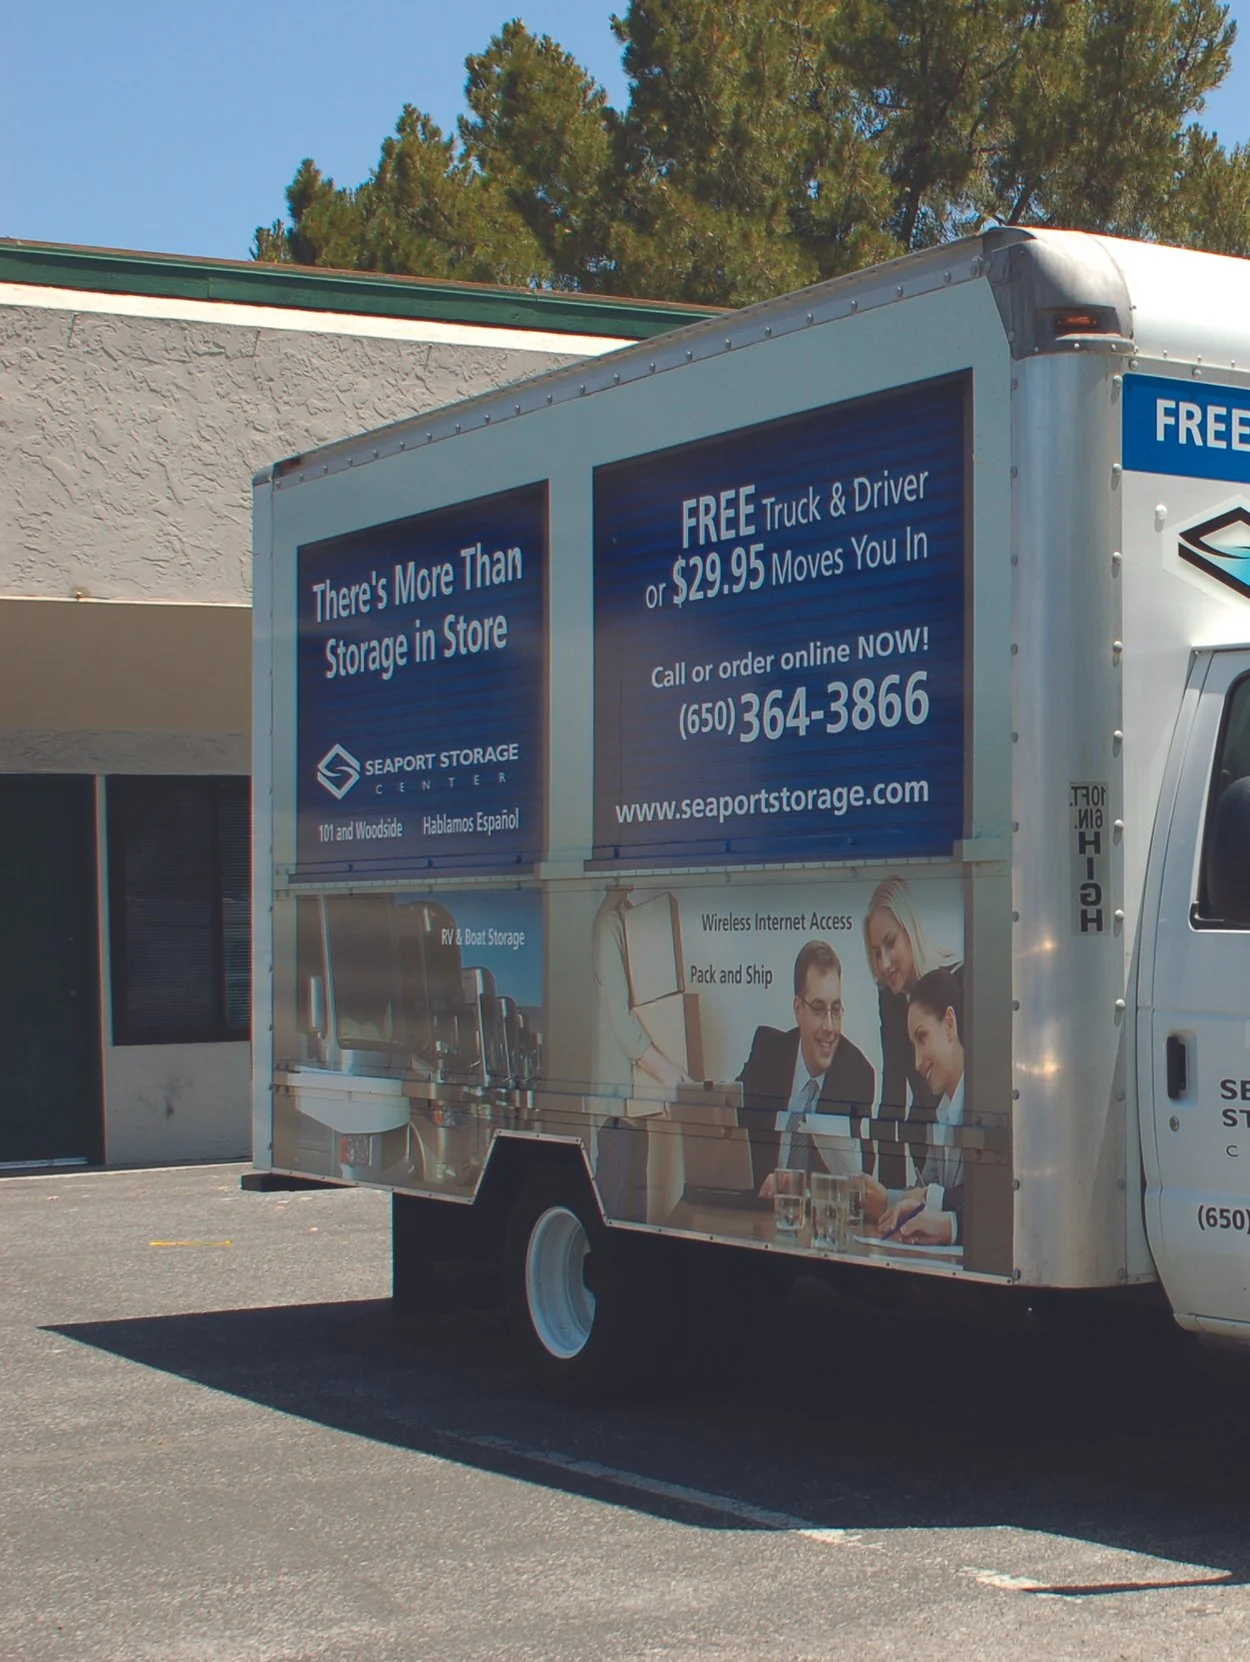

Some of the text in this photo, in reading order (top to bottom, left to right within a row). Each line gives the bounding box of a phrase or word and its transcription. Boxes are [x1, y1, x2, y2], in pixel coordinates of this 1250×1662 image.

[682, 470, 928, 548] FREE Truck & Driver
[312, 543, 523, 622] There's More Than
[646, 526, 928, 608] or $29.95 Moves You In
[326, 614, 508, 680] Storage in Store
[651, 626, 929, 688] Call or order online NOW!
[679, 671, 929, 743] (650) 364-3866
[365, 743, 519, 776] SEAPORT STORAGE
[375, 772, 507, 796] CENTER
[615, 780, 929, 823] www.seaportstorage.com
[318, 817, 403, 843] 101 and Woodside
[423, 808, 519, 836] Hablamos Español
[441, 927, 525, 950] RV & Boat Storage
[701, 911, 853, 933] Wireless Internet Access
[690, 963, 774, 988] Pack and Ship
